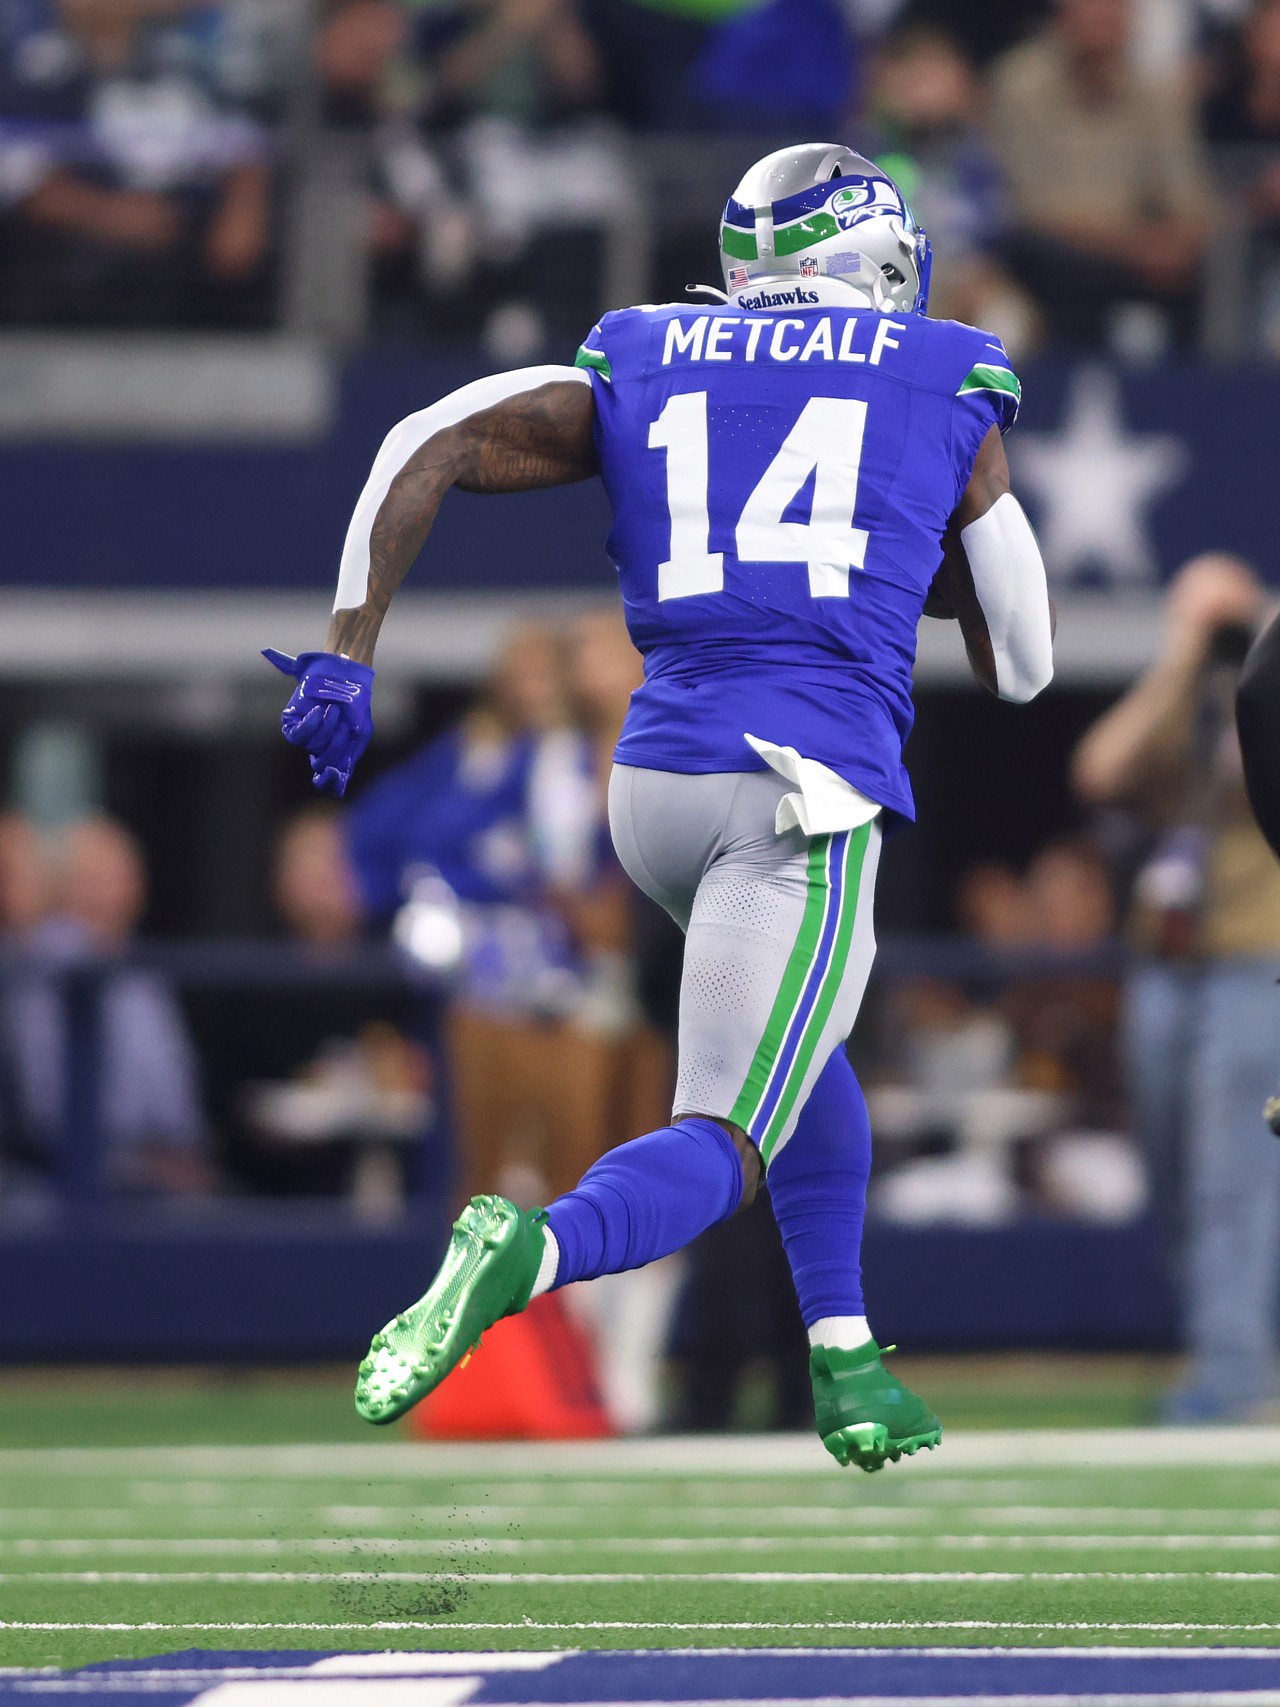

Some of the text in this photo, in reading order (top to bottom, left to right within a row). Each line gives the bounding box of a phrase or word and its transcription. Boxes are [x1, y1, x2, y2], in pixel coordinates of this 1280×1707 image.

[801, 265, 818, 277] NFL
[738, 286, 820, 310] Seahawks
[662, 317, 906, 366] METCALF
[648, 390, 869, 603] 14
